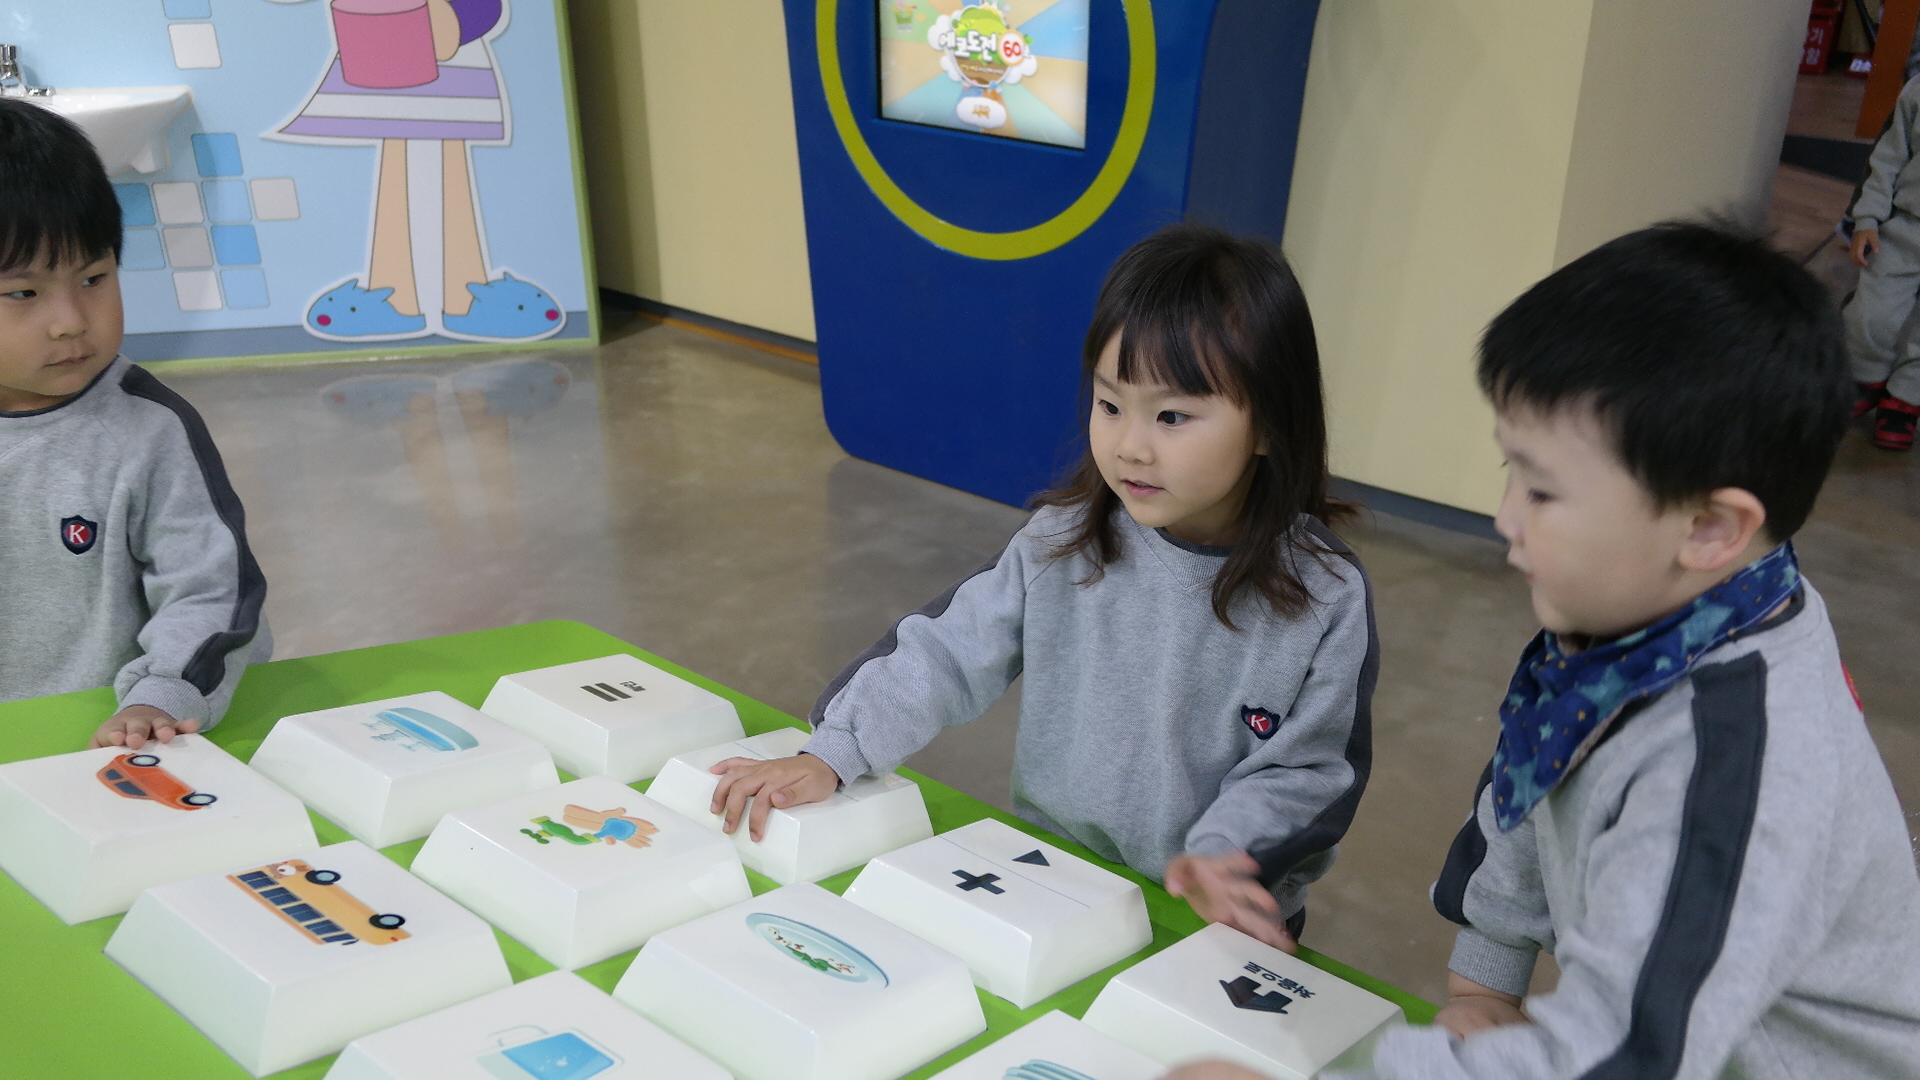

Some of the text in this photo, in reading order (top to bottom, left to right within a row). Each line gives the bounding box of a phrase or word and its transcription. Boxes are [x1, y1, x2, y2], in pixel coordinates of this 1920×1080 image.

[70, 524, 86, 544] K
[1251, 714, 1267, 732] K
[1243, 961, 1317, 999] 처음으로
